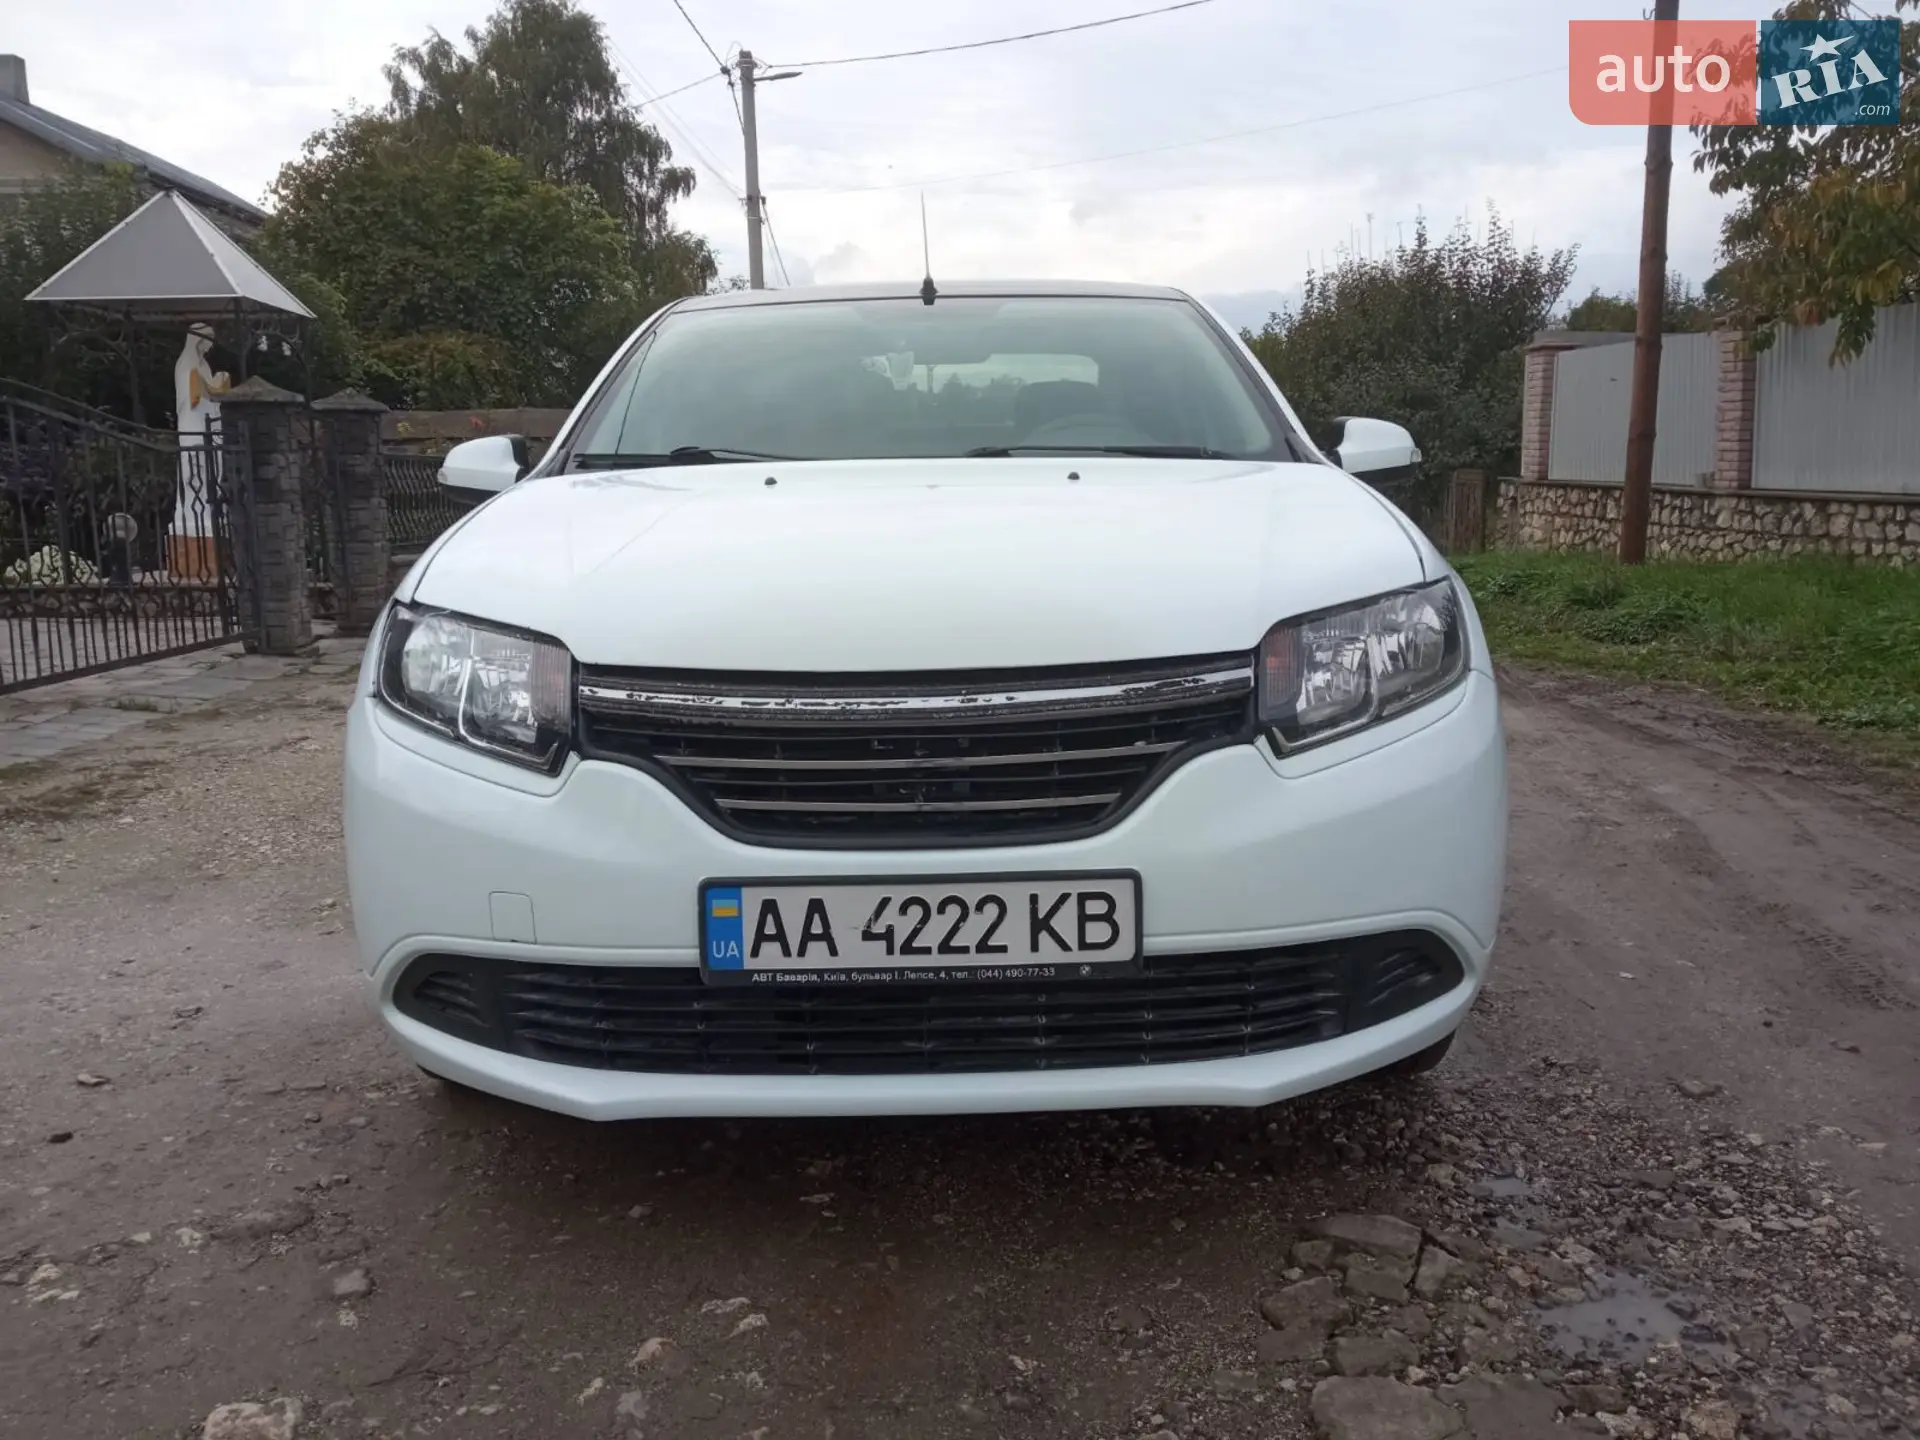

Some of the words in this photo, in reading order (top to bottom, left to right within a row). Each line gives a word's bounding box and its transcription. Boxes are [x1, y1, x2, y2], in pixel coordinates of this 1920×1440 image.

[749, 897, 839, 959] AA
[861, 893, 1008, 956] 4222
[1029, 890, 1120, 954] KB
[712, 940, 740, 959] UA
[851, 971, 892, 983] бульвар
[977, 968, 1003, 980] (044)
[1005, 967, 1056, 978] 490-77-33
